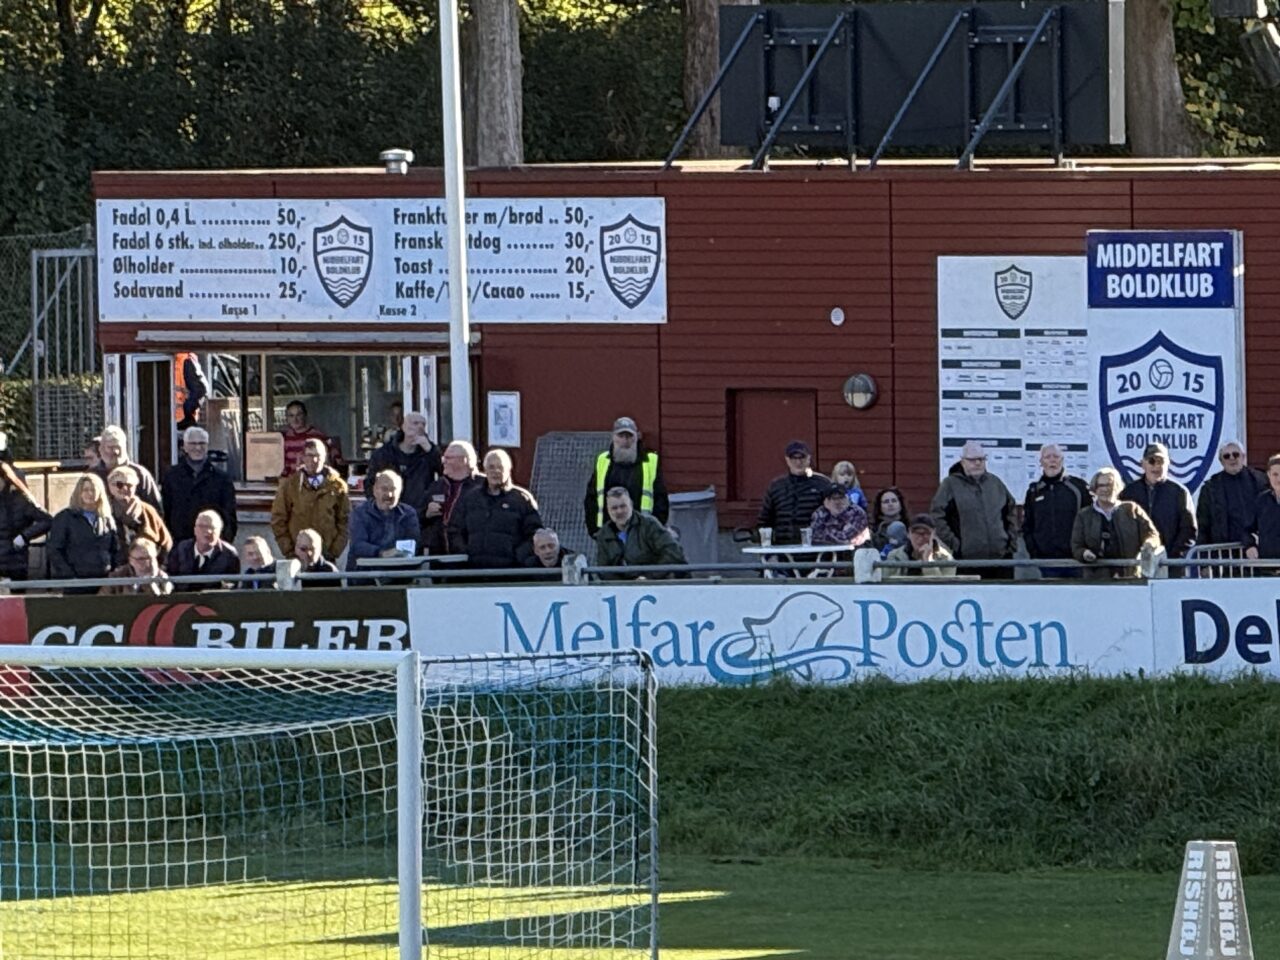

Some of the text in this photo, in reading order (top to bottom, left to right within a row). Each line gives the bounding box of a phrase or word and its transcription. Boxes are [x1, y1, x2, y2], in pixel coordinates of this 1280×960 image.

[112, 208, 150, 226] Fadøl
[156, 208, 180, 229] 0,4
[276, 208, 306, 229] 50,-
[394, 206, 594, 229] Frankfuer m/brød 50,-
[112, 232, 150, 250] Fadøl
[155, 233, 163, 250] 6
[168, 232, 194, 250] stk.
[268, 233, 306, 253] 250,-
[321, 234, 334, 246] 20
[353, 234, 365, 246] 15
[395, 231, 594, 254] Fransk tdog 30,-
[608, 234, 621, 246] 20
[641, 234, 651, 246] 15
[1096, 242, 1223, 268] MIDDELFART
[112, 256, 307, 278] Ølholder 10,-
[394, 257, 594, 277] Toast 20,-
[113, 281, 307, 302] Sodavand 25,-
[567, 281, 595, 302] 15,-
[1106, 273, 1214, 298] BOLDKLUB
[222, 304, 257, 316] Kasse 1
[379, 304, 417, 316] Kasse 2
[1116, 371, 1141, 393] 20
[1182, 371, 1204, 393] 15
[1119, 413, 1204, 429] MIDDELFART
[1126, 433, 1198, 450] BOLDKLUB
[495, 594, 1075, 669] Melfar Posten
